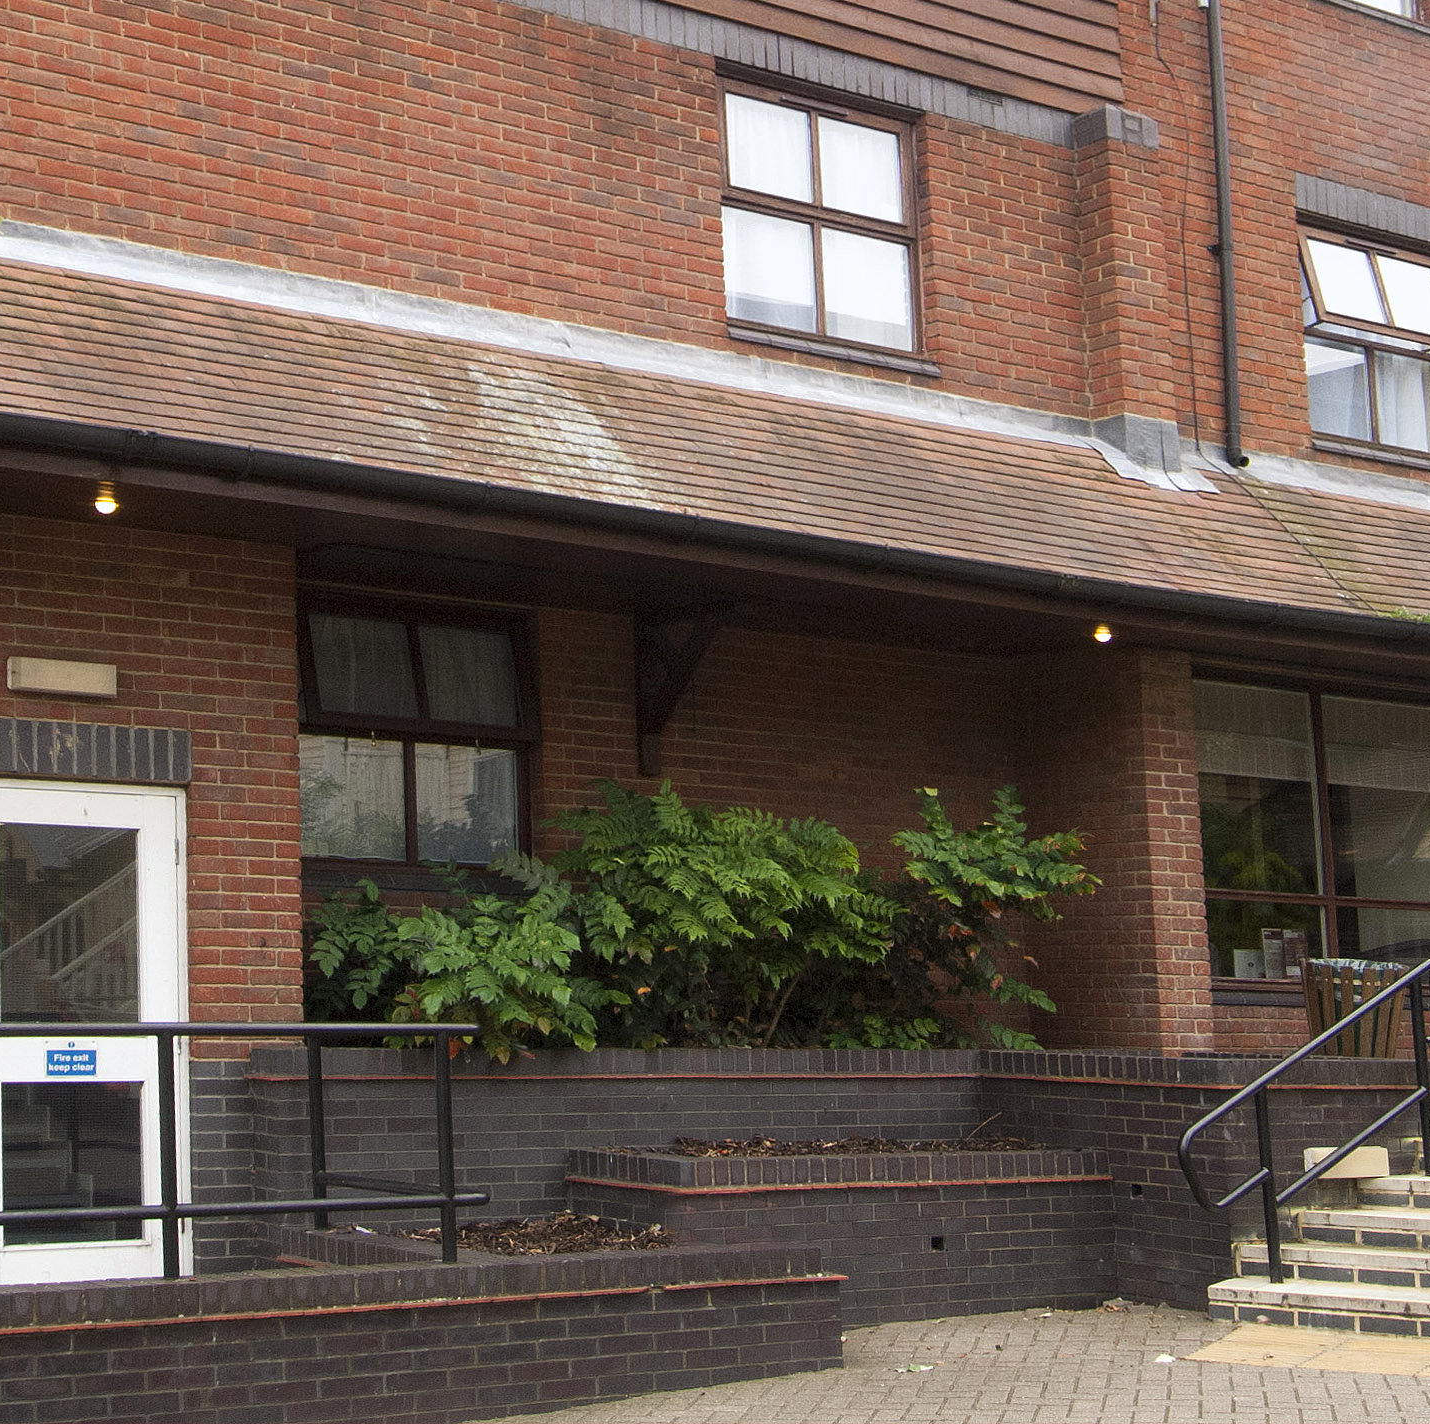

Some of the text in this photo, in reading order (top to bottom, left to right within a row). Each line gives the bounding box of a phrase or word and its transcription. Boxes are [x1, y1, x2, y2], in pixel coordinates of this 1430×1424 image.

[53, 1053, 89, 1062] Fire exit
[48, 1062, 95, 1073] keep clear
